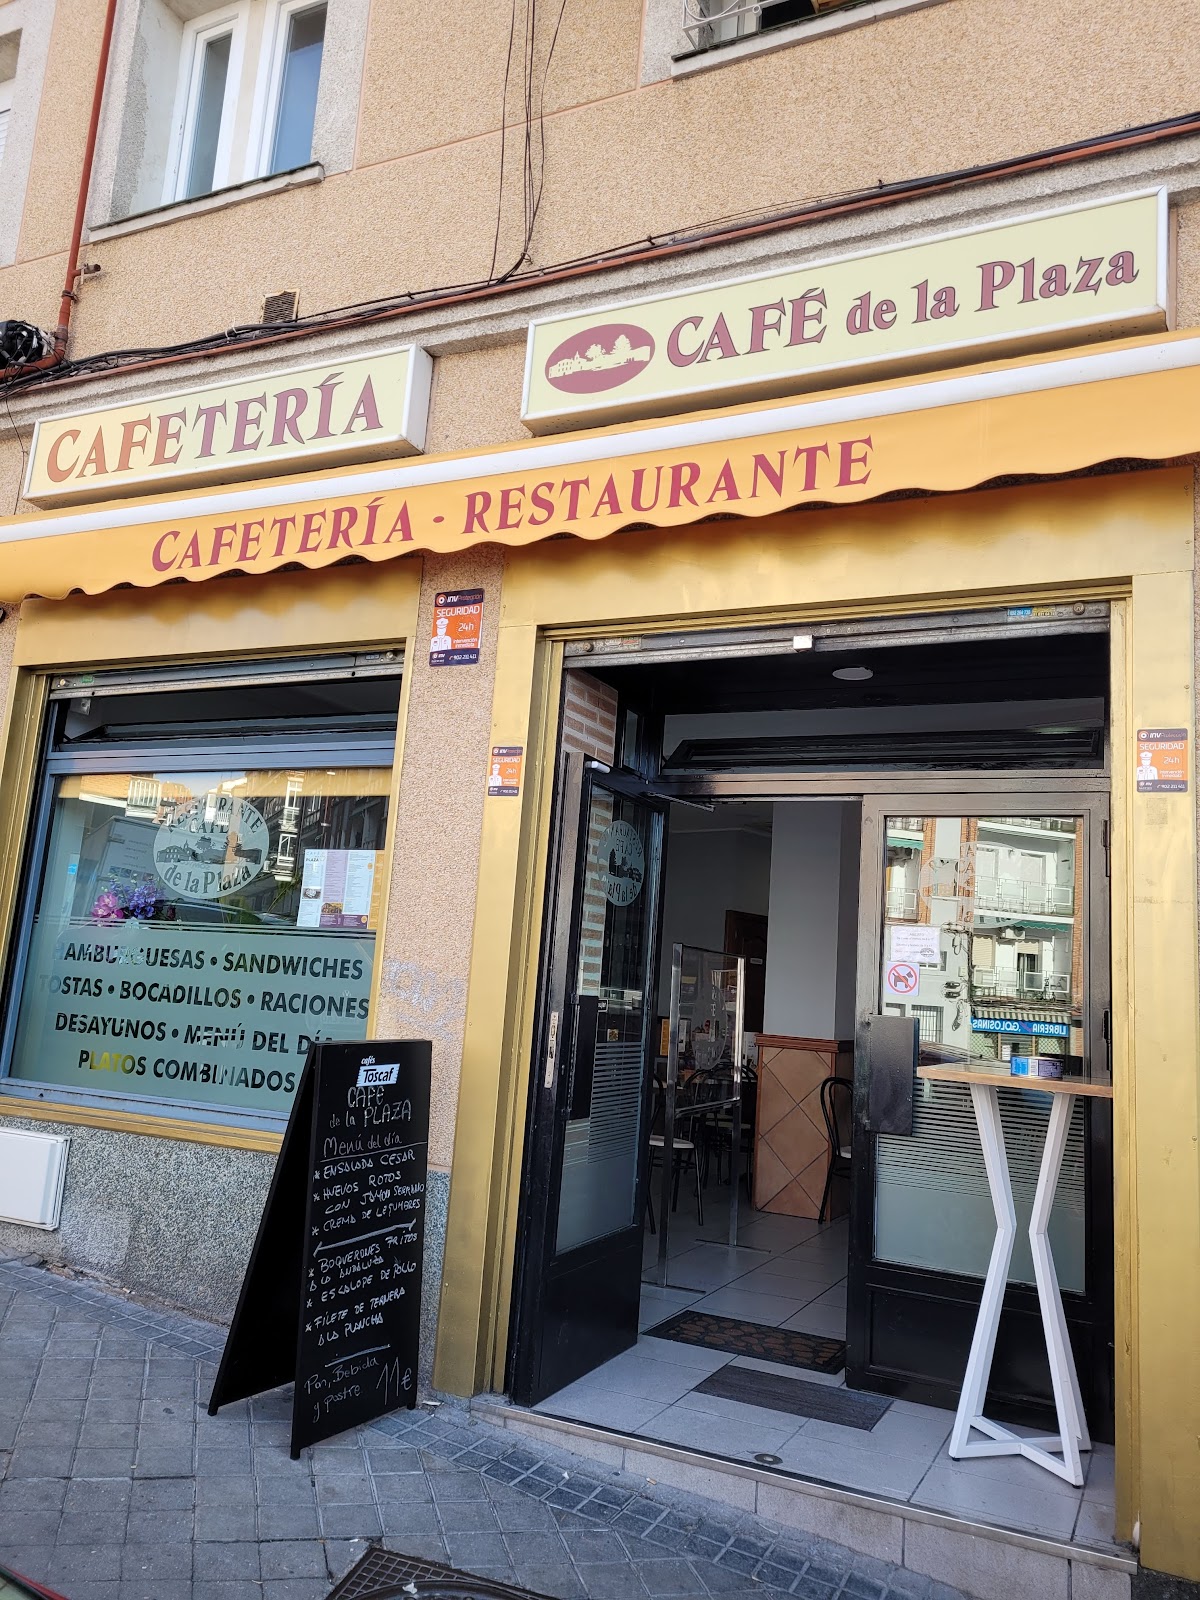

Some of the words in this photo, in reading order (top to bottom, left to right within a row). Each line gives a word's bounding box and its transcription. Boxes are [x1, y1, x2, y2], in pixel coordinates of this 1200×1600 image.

[667, 287, 828, 369] CAFÉ
[846, 291, 897, 337] de
[911, 279, 958, 324] la
[975, 249, 1140, 313] Plaza
[46, 371, 384, 484] CAFETERÍA
[151, 496, 414, 573] CAFETERÍA
[461, 434, 876, 536] RESTAURANTE
[436, 605, 480, 618] SEGURIDAD
[458, 622, 475, 632] 24h
[1139, 742, 1185, 751] SEGURIDAD
[1163, 756, 1180, 765] 24h
[163, 864, 182, 887] de
[184, 871, 199, 893] la
[203, 865, 252, 894] Plaza
[222, 951, 363, 980] SANDWICHES
[39, 974, 103, 998] TOSTAS
[119, 980, 242, 1009] BOCADILLOS
[260, 991, 370, 1020] RACIONES
[55, 1012, 167, 1042] DESAYUNOS
[183, 1022, 246, 1050] MENÚ
[252, 1030, 289, 1054] DEL
[78, 1049, 147, 1076] PLATOS
[153, 1058, 296, 1093] COMBINADOS
[363, 1067, 395, 1084] Toscaf
[329, 1113, 341, 1129] de
[345, 1110, 356, 1127] la
[363, 1099, 412, 1128] PLAZA
[323, 1133, 363, 1158] Menú
[367, 1135, 381, 1150] del
[384, 1131, 403, 1146] día
[323, 1157, 374, 1180] ENSALADA
[380, 1148, 416, 1166] CESAR
[323, 1181, 359, 1200] HUEVOS
[368, 1170, 402, 1187] ROTOS
[324, 1198, 351, 1215] CON
[323, 1214, 357, 1232] CREMA
[318, 1243, 381, 1274] BOQUERONES
[380, 1268, 391, 1280] DE
[393, 1260, 417, 1279] POLLO
[354, 1302, 365, 1315] DE
[369, 1286, 406, 1310] TERNERA
[344, 1312, 384, 1338] PLANCHA
[332, 1356, 380, 1383] Bebida
[312, 1402, 320, 1423] y
